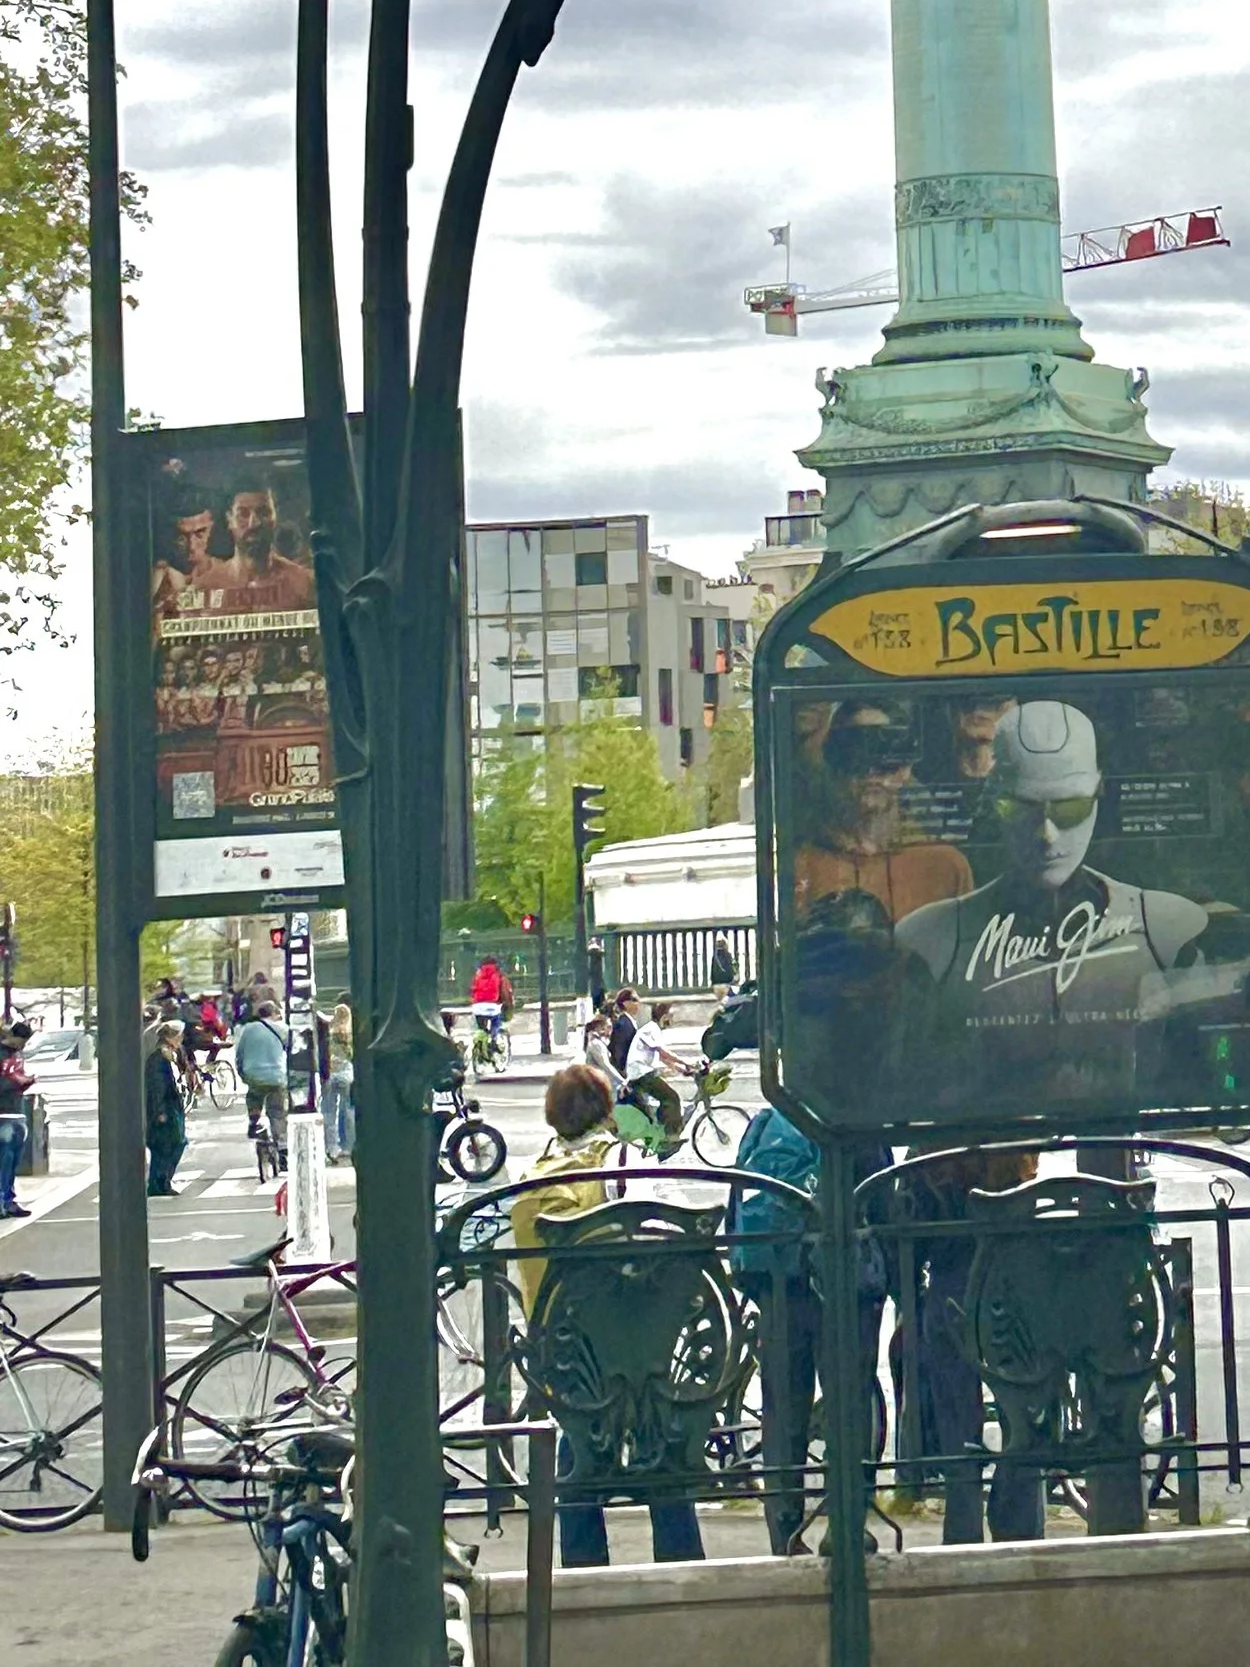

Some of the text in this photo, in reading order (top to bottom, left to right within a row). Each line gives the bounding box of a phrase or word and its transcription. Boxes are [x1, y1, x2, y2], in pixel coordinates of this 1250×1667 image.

[934, 595, 1161, 667] BASTILLE
[964, 900, 1136, 994] Maui Jim
